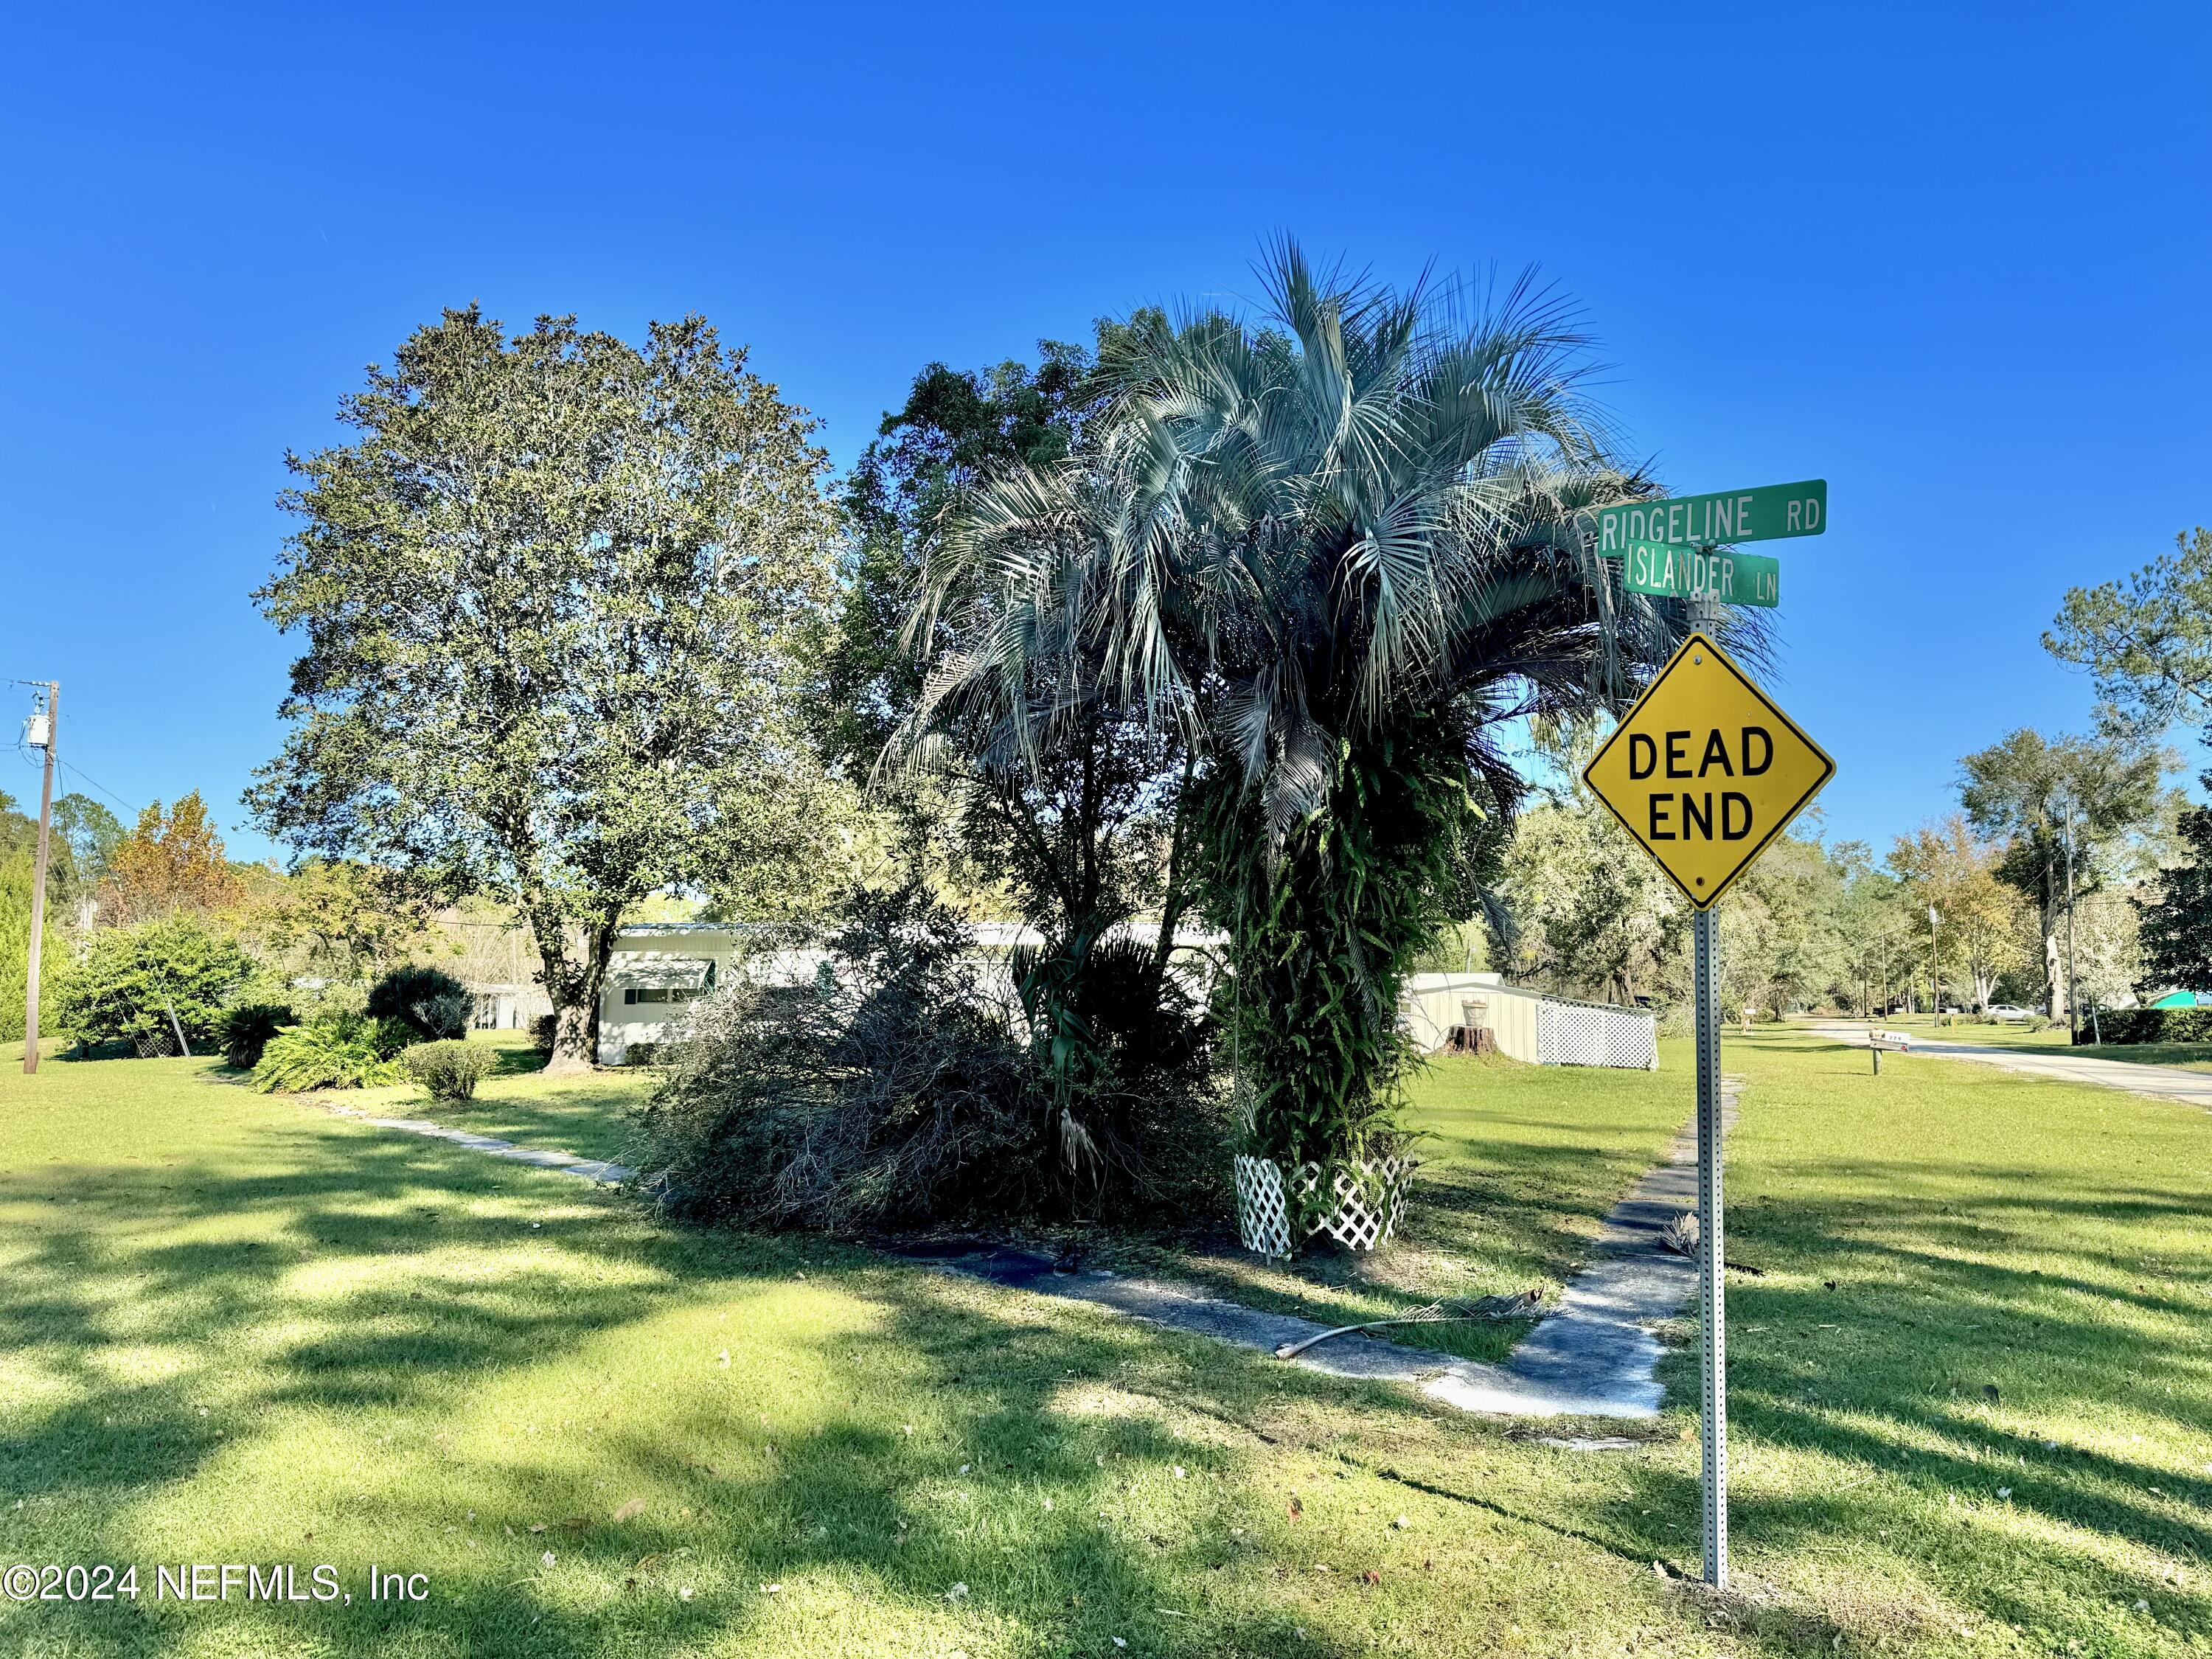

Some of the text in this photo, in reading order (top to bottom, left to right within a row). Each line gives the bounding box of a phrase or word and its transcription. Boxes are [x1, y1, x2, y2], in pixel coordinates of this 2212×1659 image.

[1601, 495, 1820, 551] RIDGELINE RD
[1627, 543, 1776, 602] ISLANDER LN
[1629, 726, 1773, 780] DEAD
[1649, 792, 1753, 841] END
